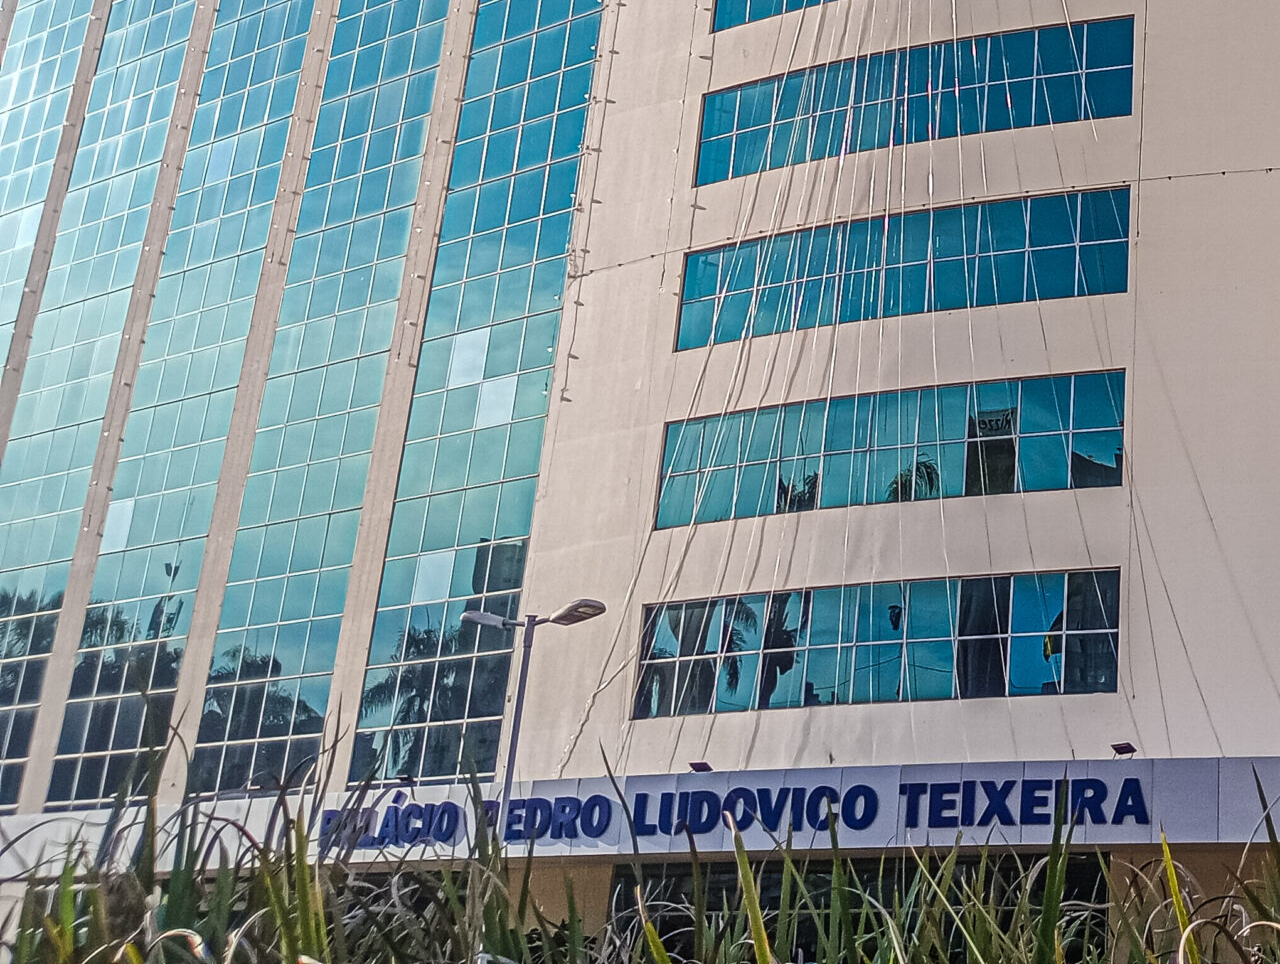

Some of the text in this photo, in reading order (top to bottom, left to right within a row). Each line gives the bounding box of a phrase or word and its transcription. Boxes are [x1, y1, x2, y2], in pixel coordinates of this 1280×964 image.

[319, 789, 459, 847] PLÁCIO
[633, 785, 880, 836] LUDOVICO
[899, 777, 1150, 829] TEIXEIRA
